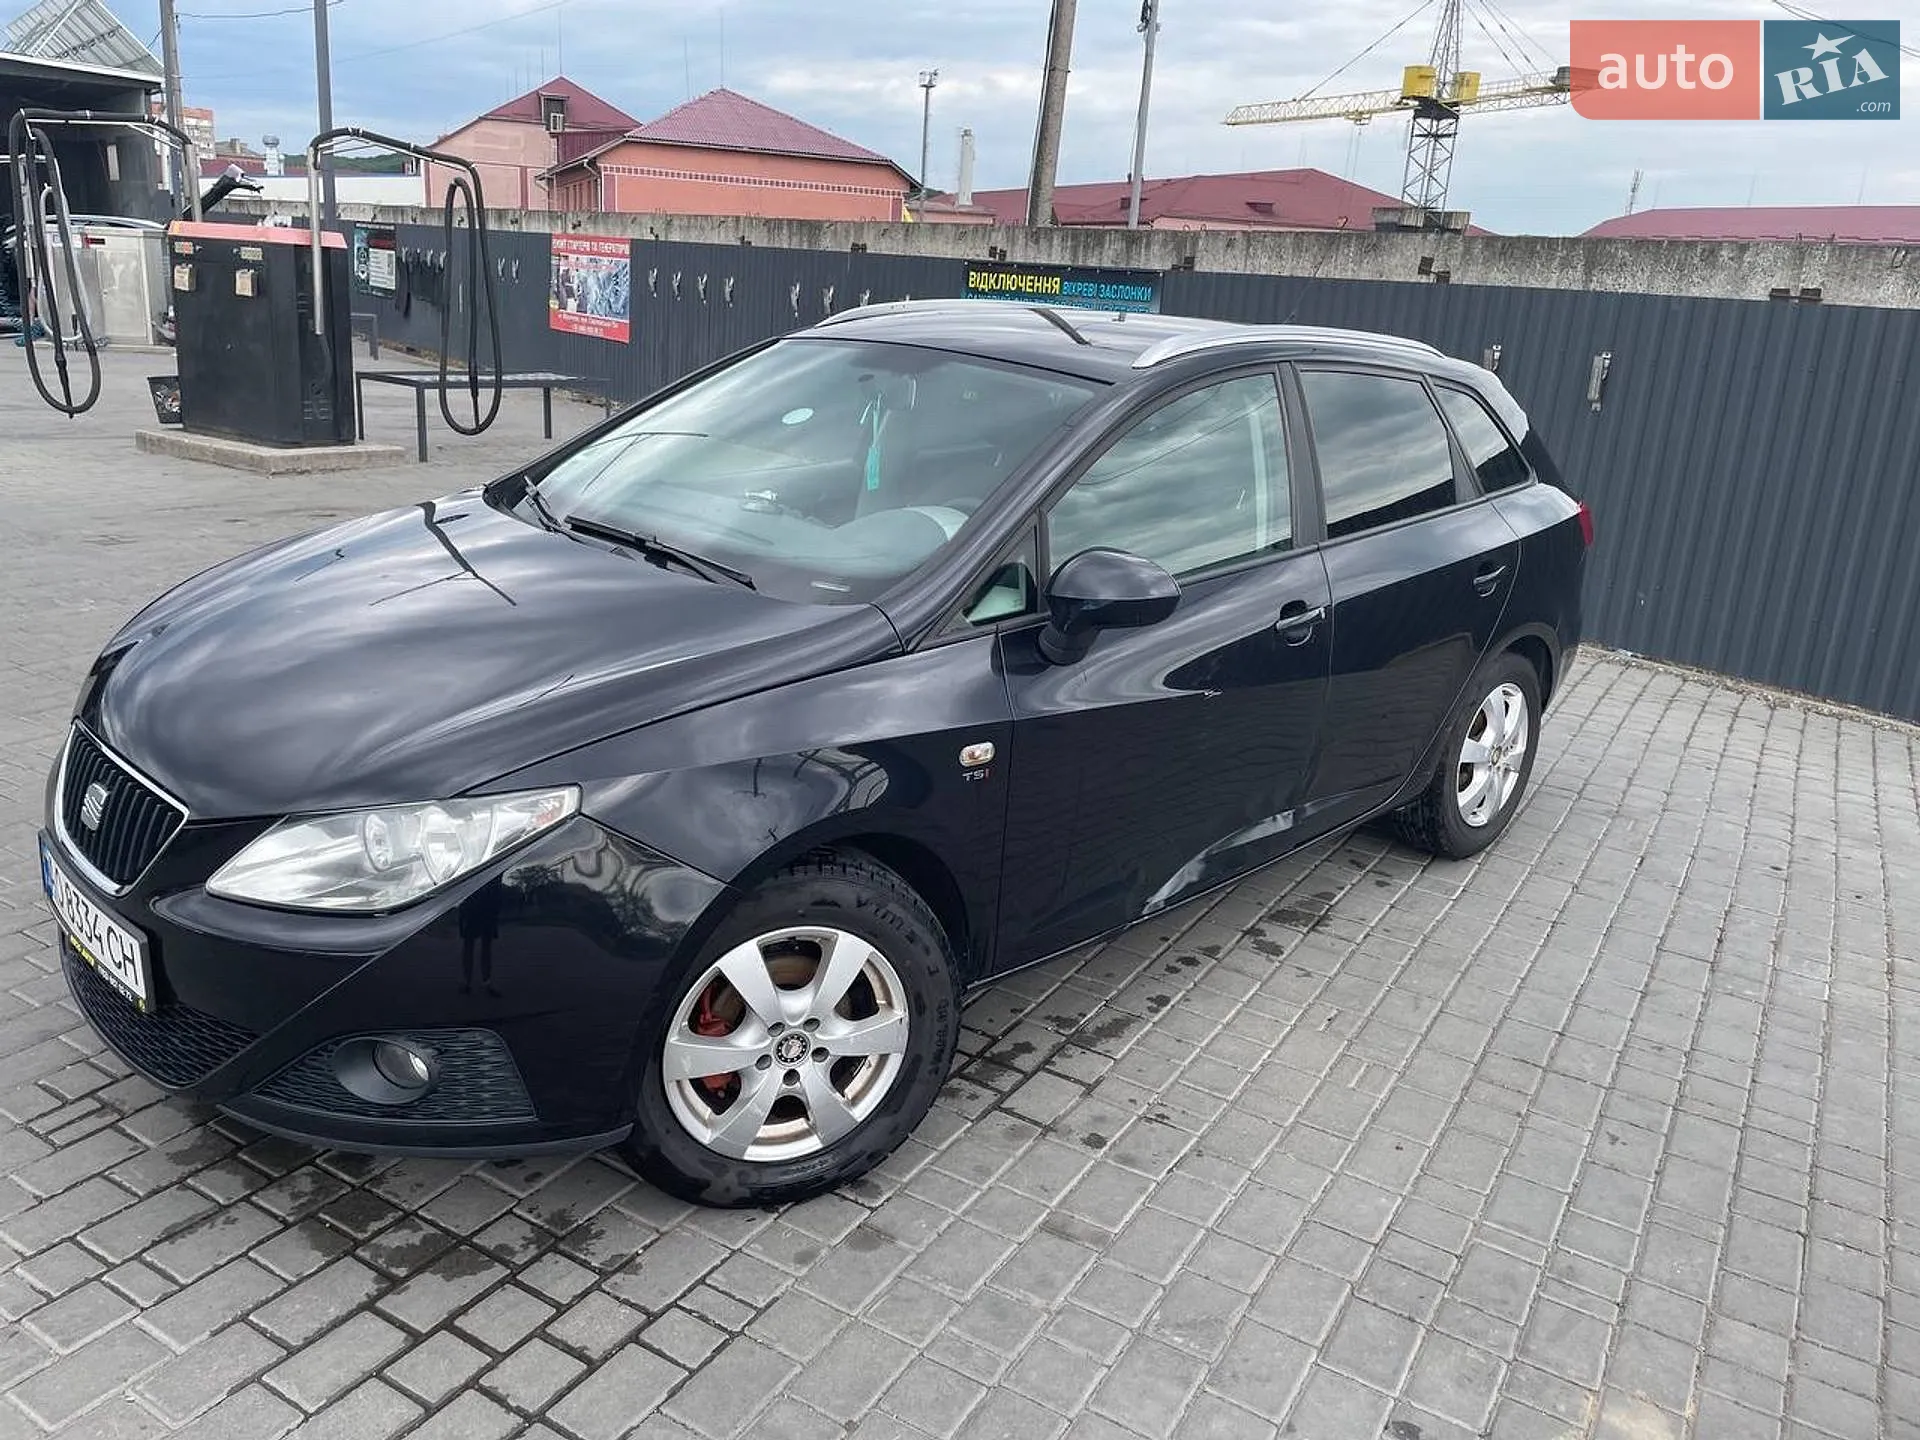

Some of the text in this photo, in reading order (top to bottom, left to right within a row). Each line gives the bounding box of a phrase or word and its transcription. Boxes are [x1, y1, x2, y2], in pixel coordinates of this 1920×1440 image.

[968, 271, 1060, 294] ВІДКЛЮЧЕННЯ
[1098, 283, 1152, 301] ЗАСЛОНКИ
[107, 925, 139, 987] CH
